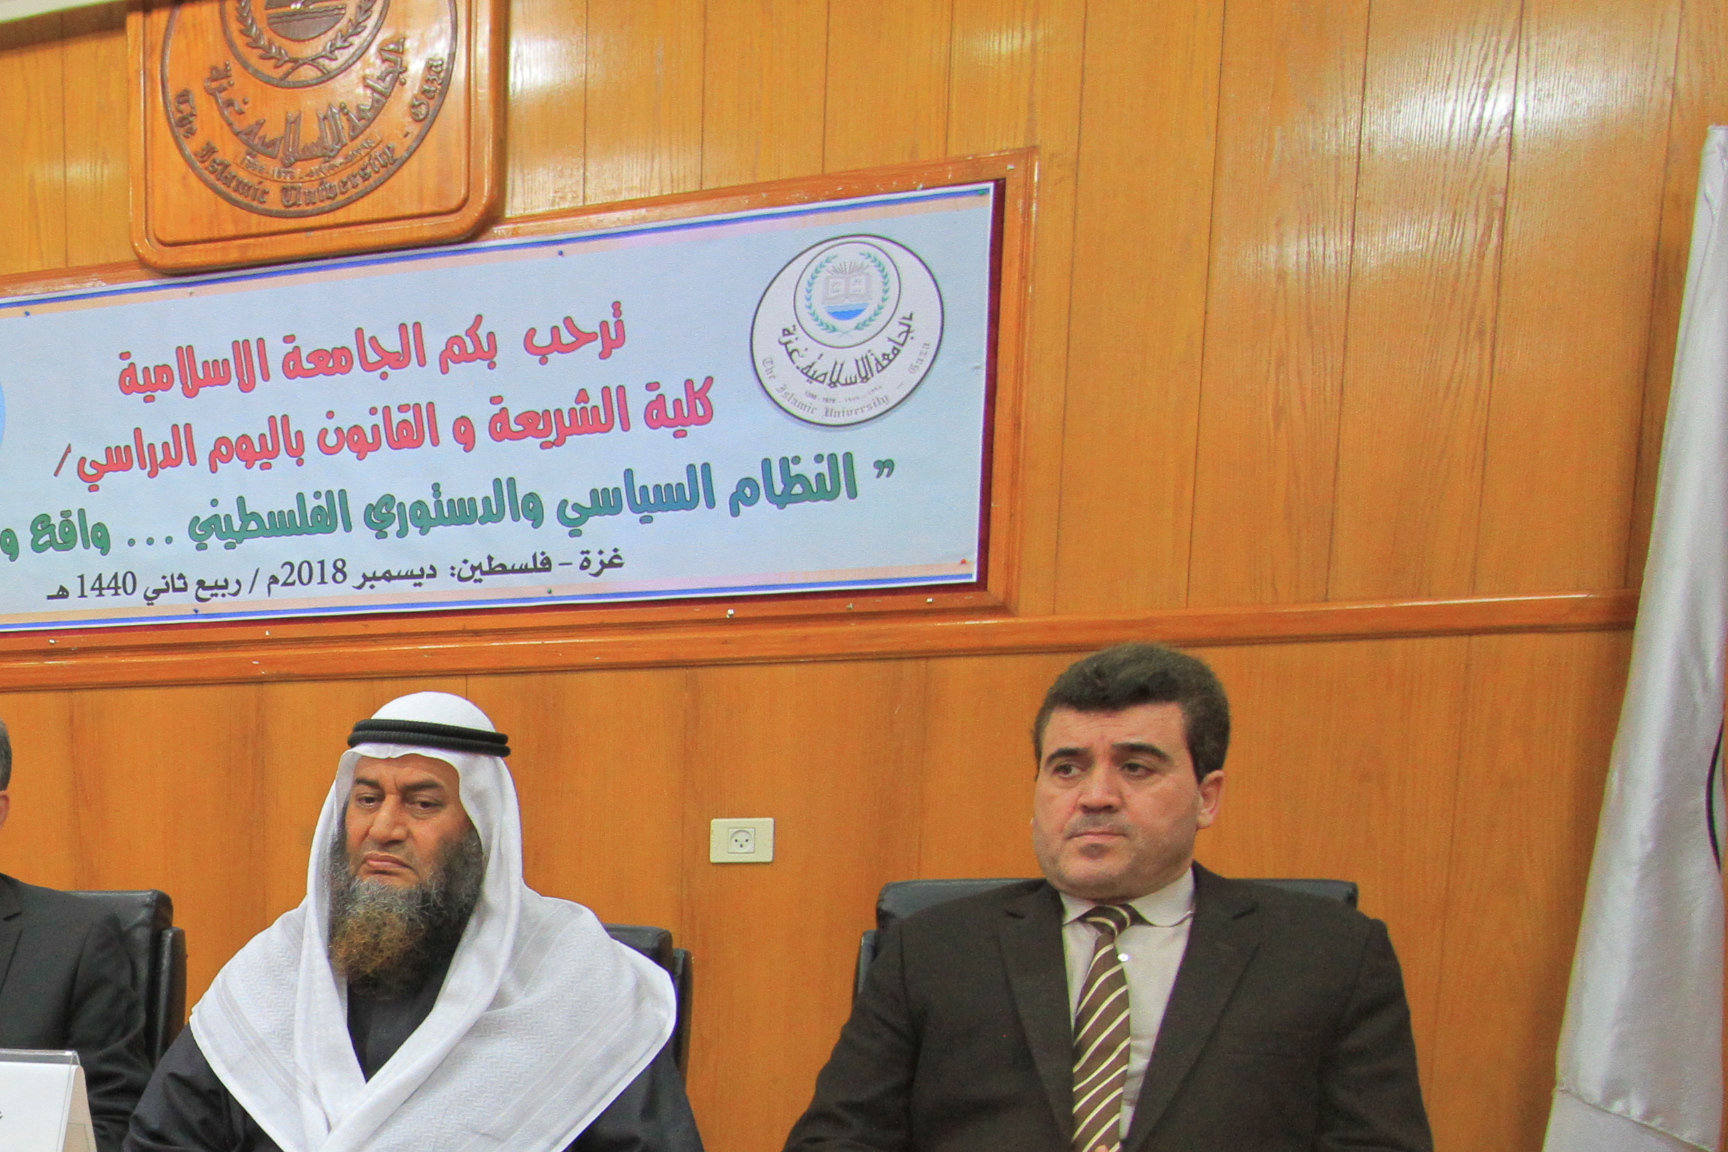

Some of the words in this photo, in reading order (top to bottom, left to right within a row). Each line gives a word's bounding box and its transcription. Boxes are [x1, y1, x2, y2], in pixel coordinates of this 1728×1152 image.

[193, 141, 270, 204] Islamic
[280, 143, 397, 208] University
[118, 337, 271, 403] الاسلامية
[281, 321, 427, 381] الجامعة
[439, 314, 498, 375] بكم
[317, 401, 441, 461] القانون
[488, 383, 632, 451] الشريعة
[644, 375, 715, 439] كلية
[208, 413, 306, 474] باليوم
[363, 477, 545, 540] والدستوري
[556, 462, 717, 538] السياسي
[728, 451, 858, 518] النظام
[29, 508, 111, 556] واقع
[188, 488, 353, 551] الفلسطيني
[77, 571, 137, 599] 1440
[143, 572, 189, 607] ثاني
[194, 574, 242, 603] ربيع
[352, 562, 437, 590] ديسمبر
[578, 547, 625, 578] غزة
